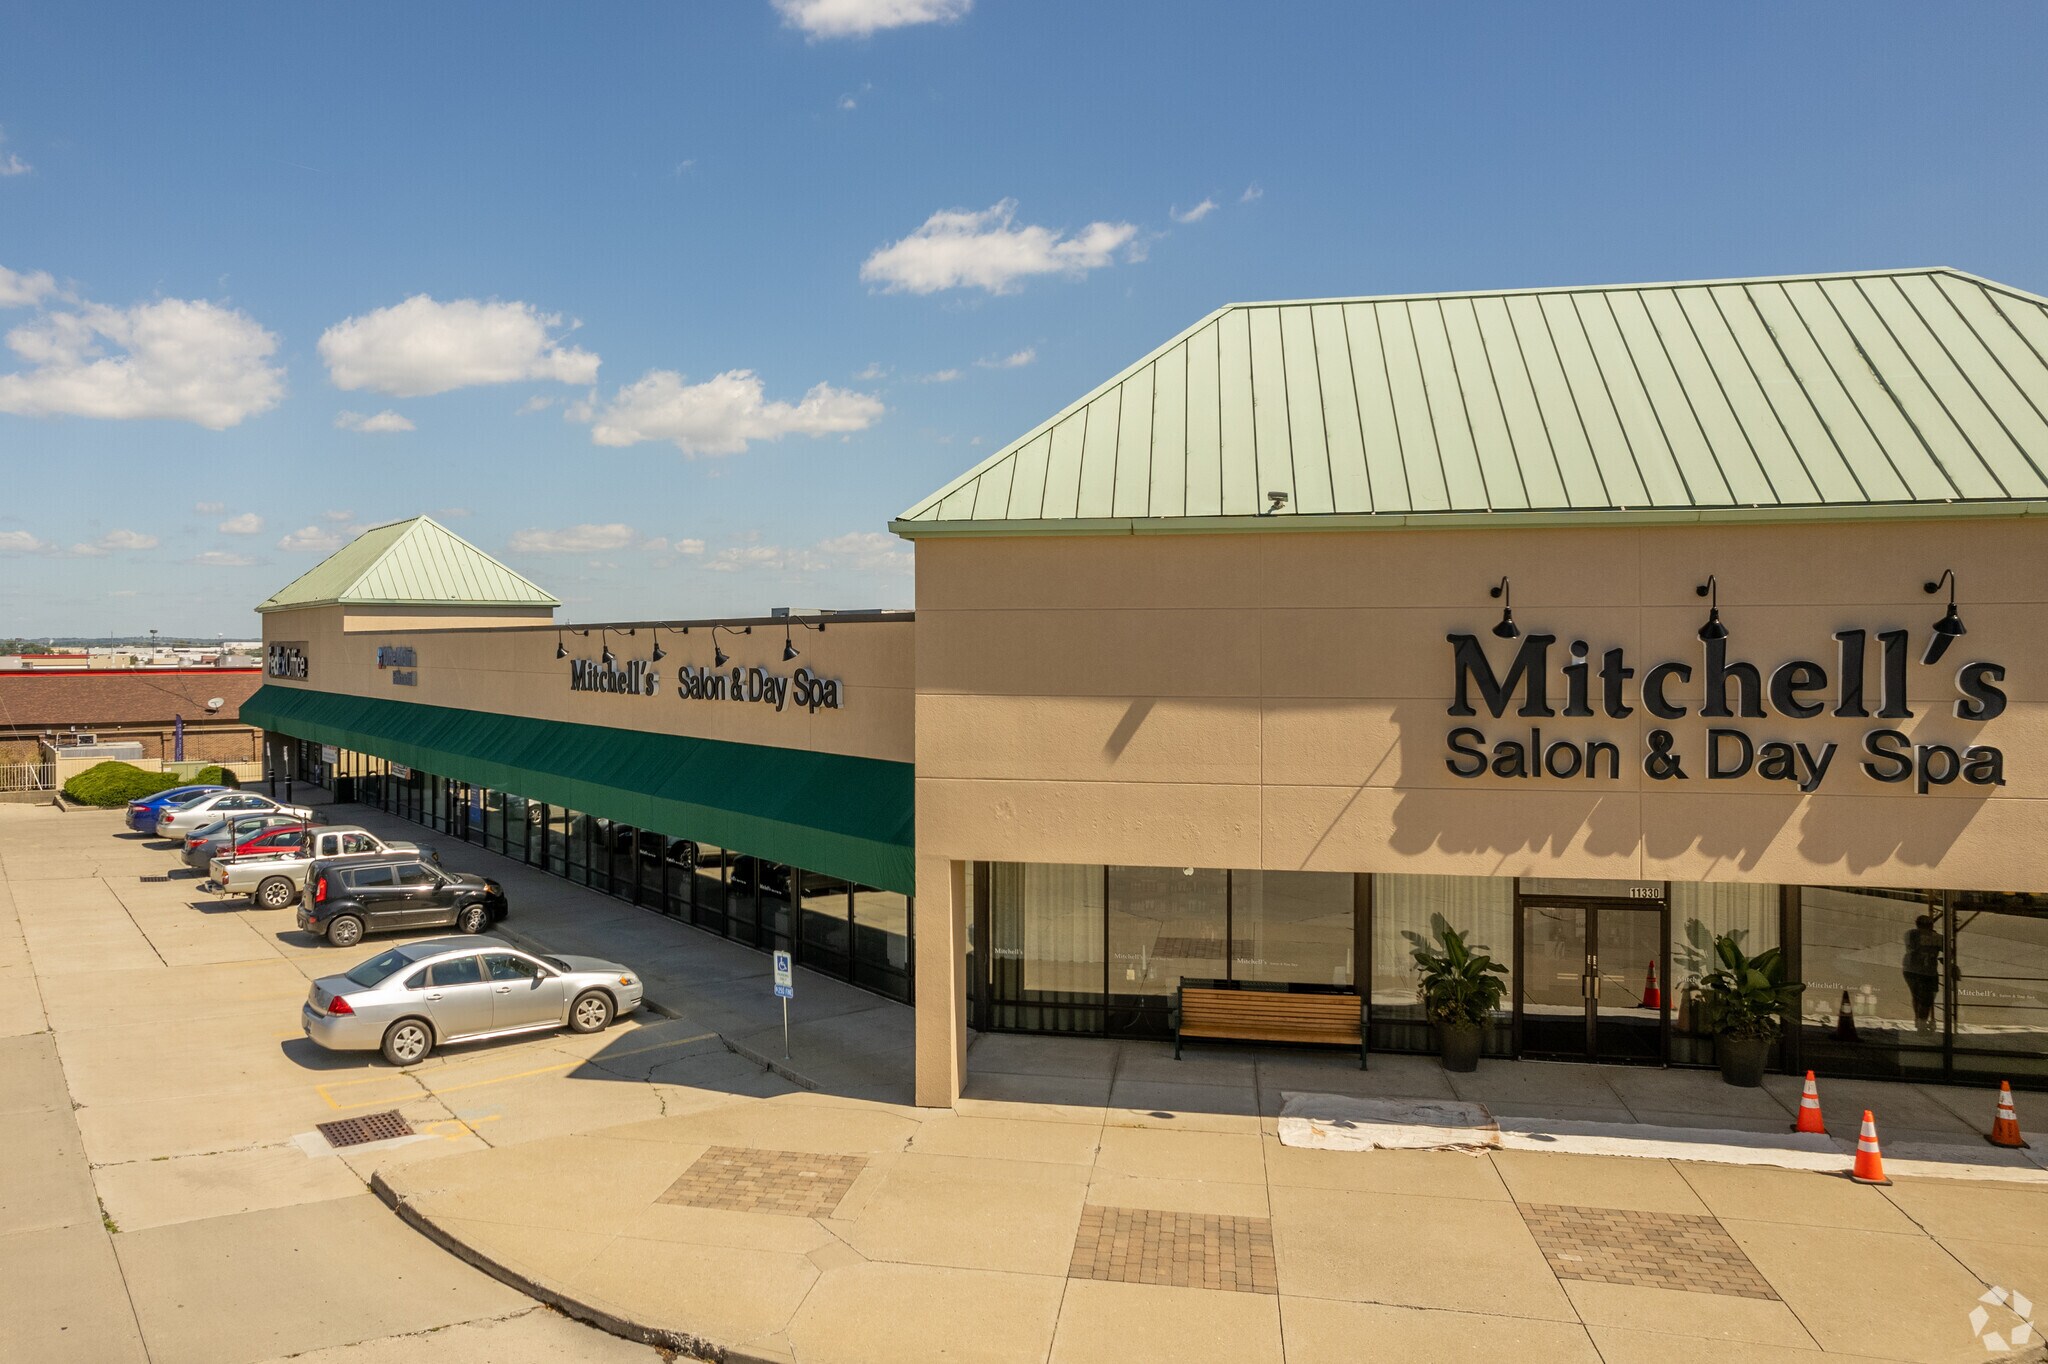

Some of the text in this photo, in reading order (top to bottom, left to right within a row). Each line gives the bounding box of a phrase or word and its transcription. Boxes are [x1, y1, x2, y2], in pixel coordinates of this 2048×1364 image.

[1445, 629, 2008, 720] Mitchell's
[570, 657, 844, 715] Mitchell's Salon & Day Spa
[1444, 727, 2007, 795] Salon & Day Spa
[1630, 888, 1660, 899] 11330
[1236, 957, 1268, 966] Mitchell's
[1807, 981, 1844, 990] Mitchell's
[1957, 988, 1996, 998] Mitchell's
